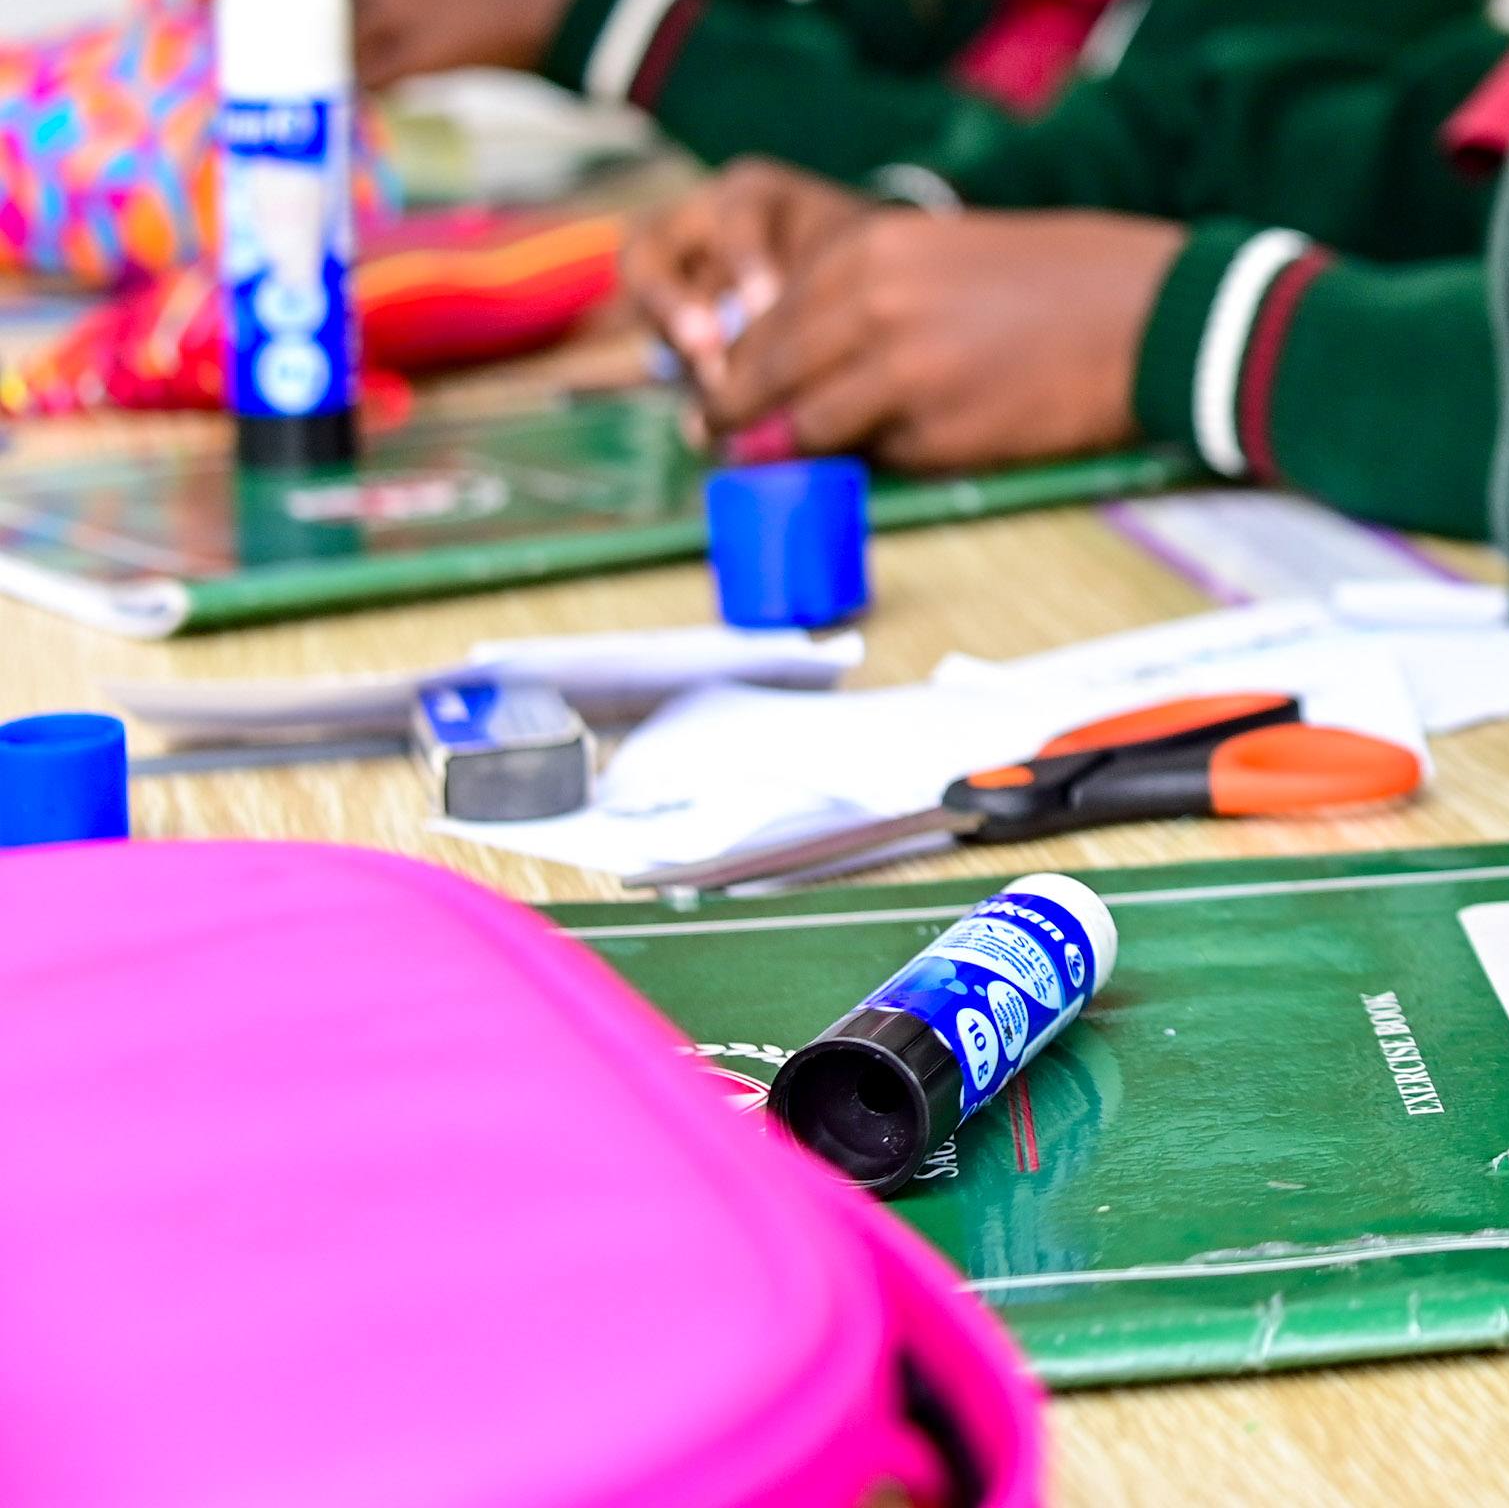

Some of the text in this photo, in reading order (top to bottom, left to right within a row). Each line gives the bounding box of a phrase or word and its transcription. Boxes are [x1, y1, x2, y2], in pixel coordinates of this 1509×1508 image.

[974, 899, 1066, 943] ikan
[1013, 936, 1056, 989] Stick
[966, 1018, 988, 1053] 10
[1360, 990, 1446, 1116] EXERCISE BOOK
